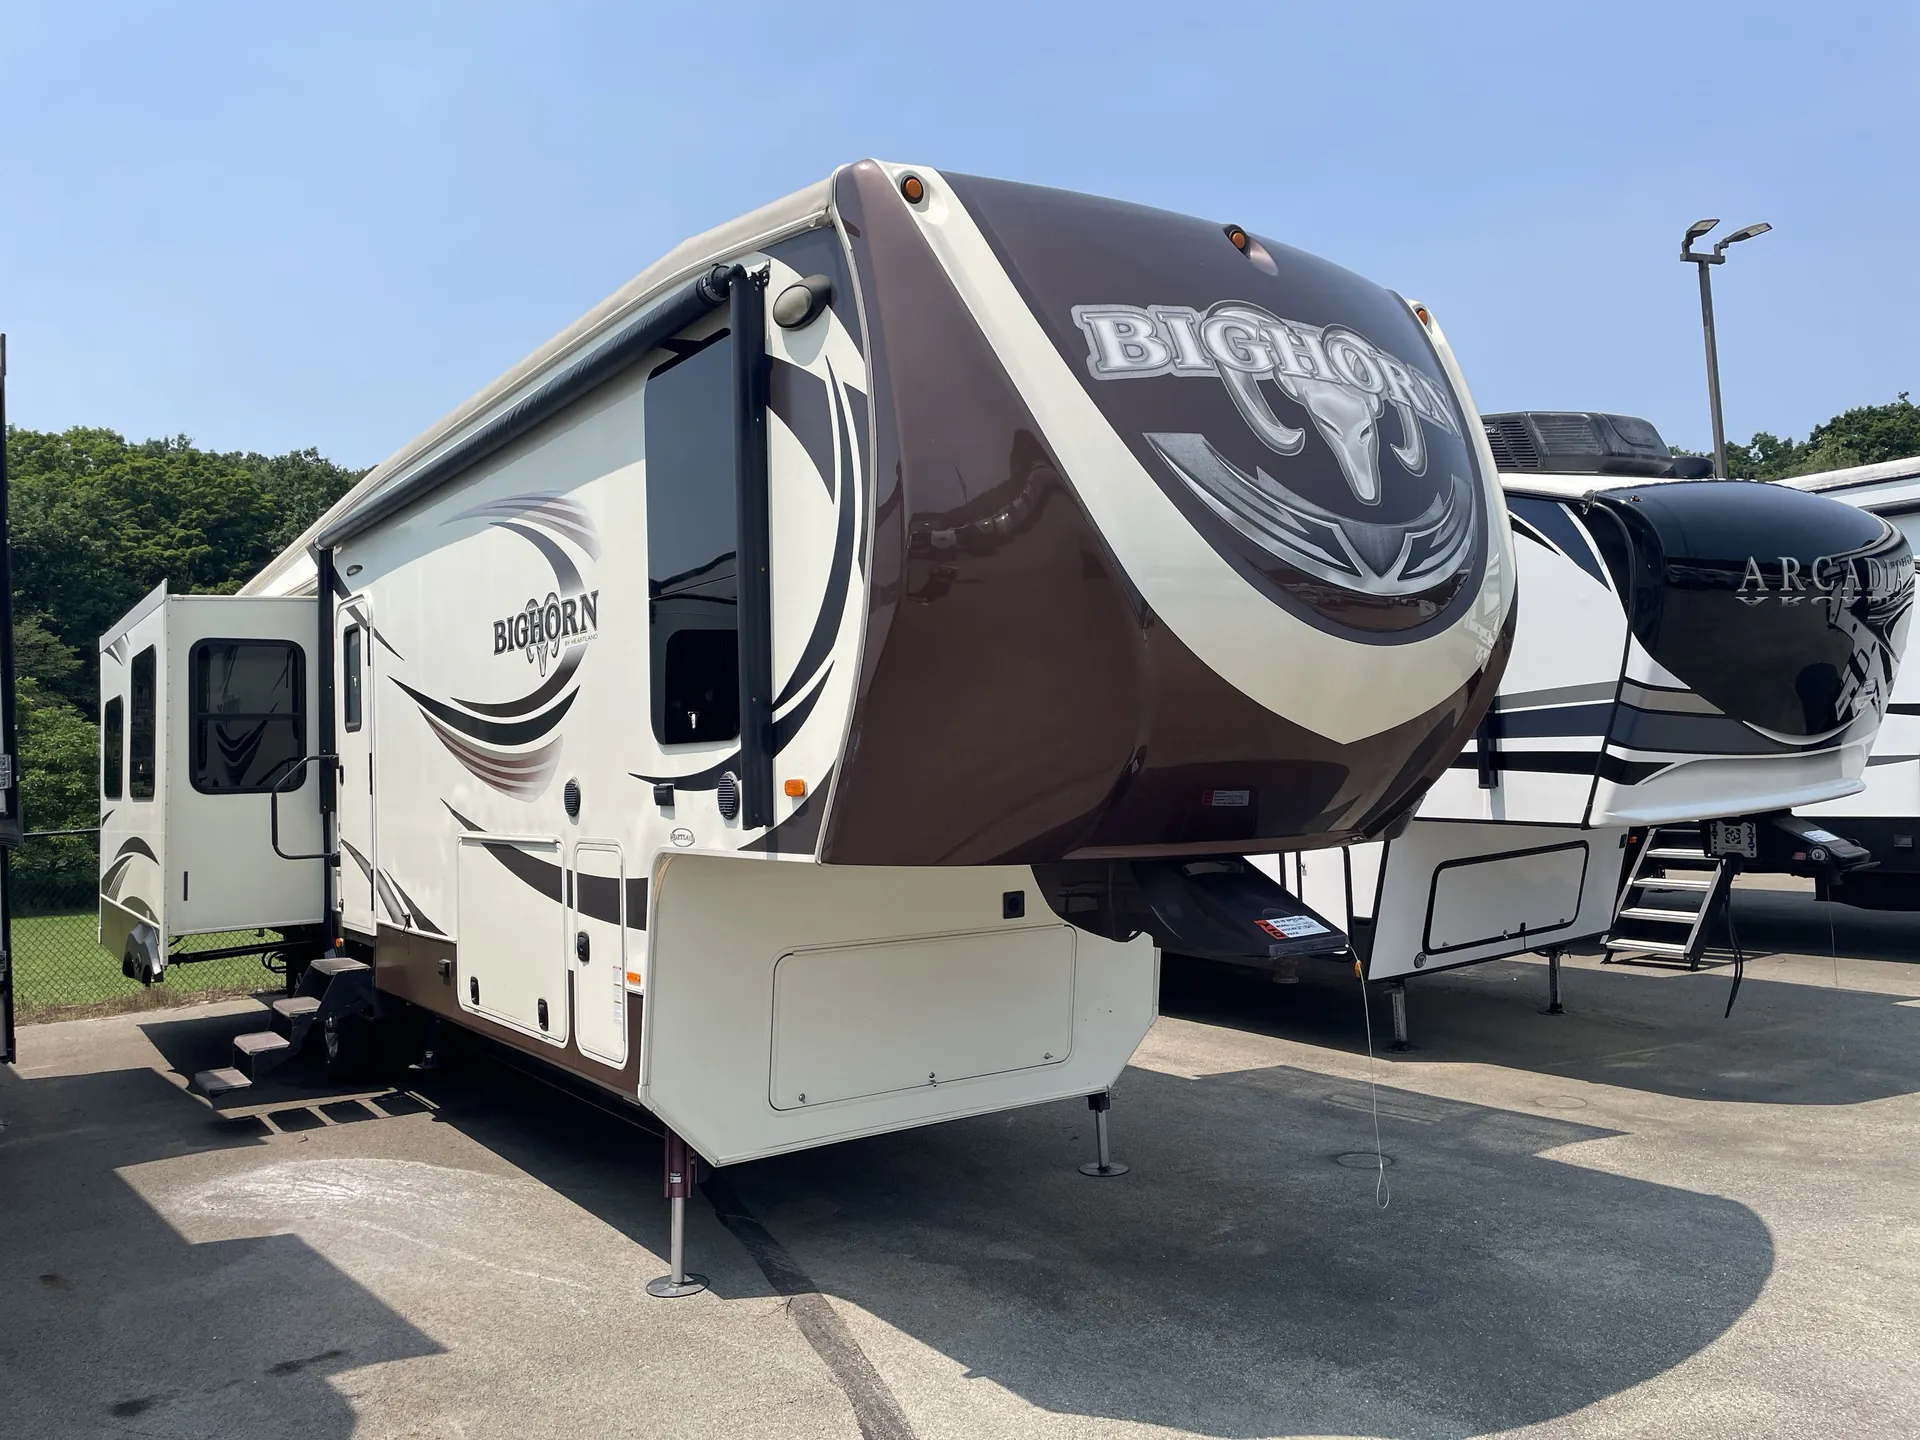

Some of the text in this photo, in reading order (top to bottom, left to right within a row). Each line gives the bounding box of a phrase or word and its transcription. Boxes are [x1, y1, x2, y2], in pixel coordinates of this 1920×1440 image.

[1073, 304, 1460, 438] BIGHORN
[1735, 556, 1904, 593] ARCADIA
[493, 590, 599, 656] BIGHORN
